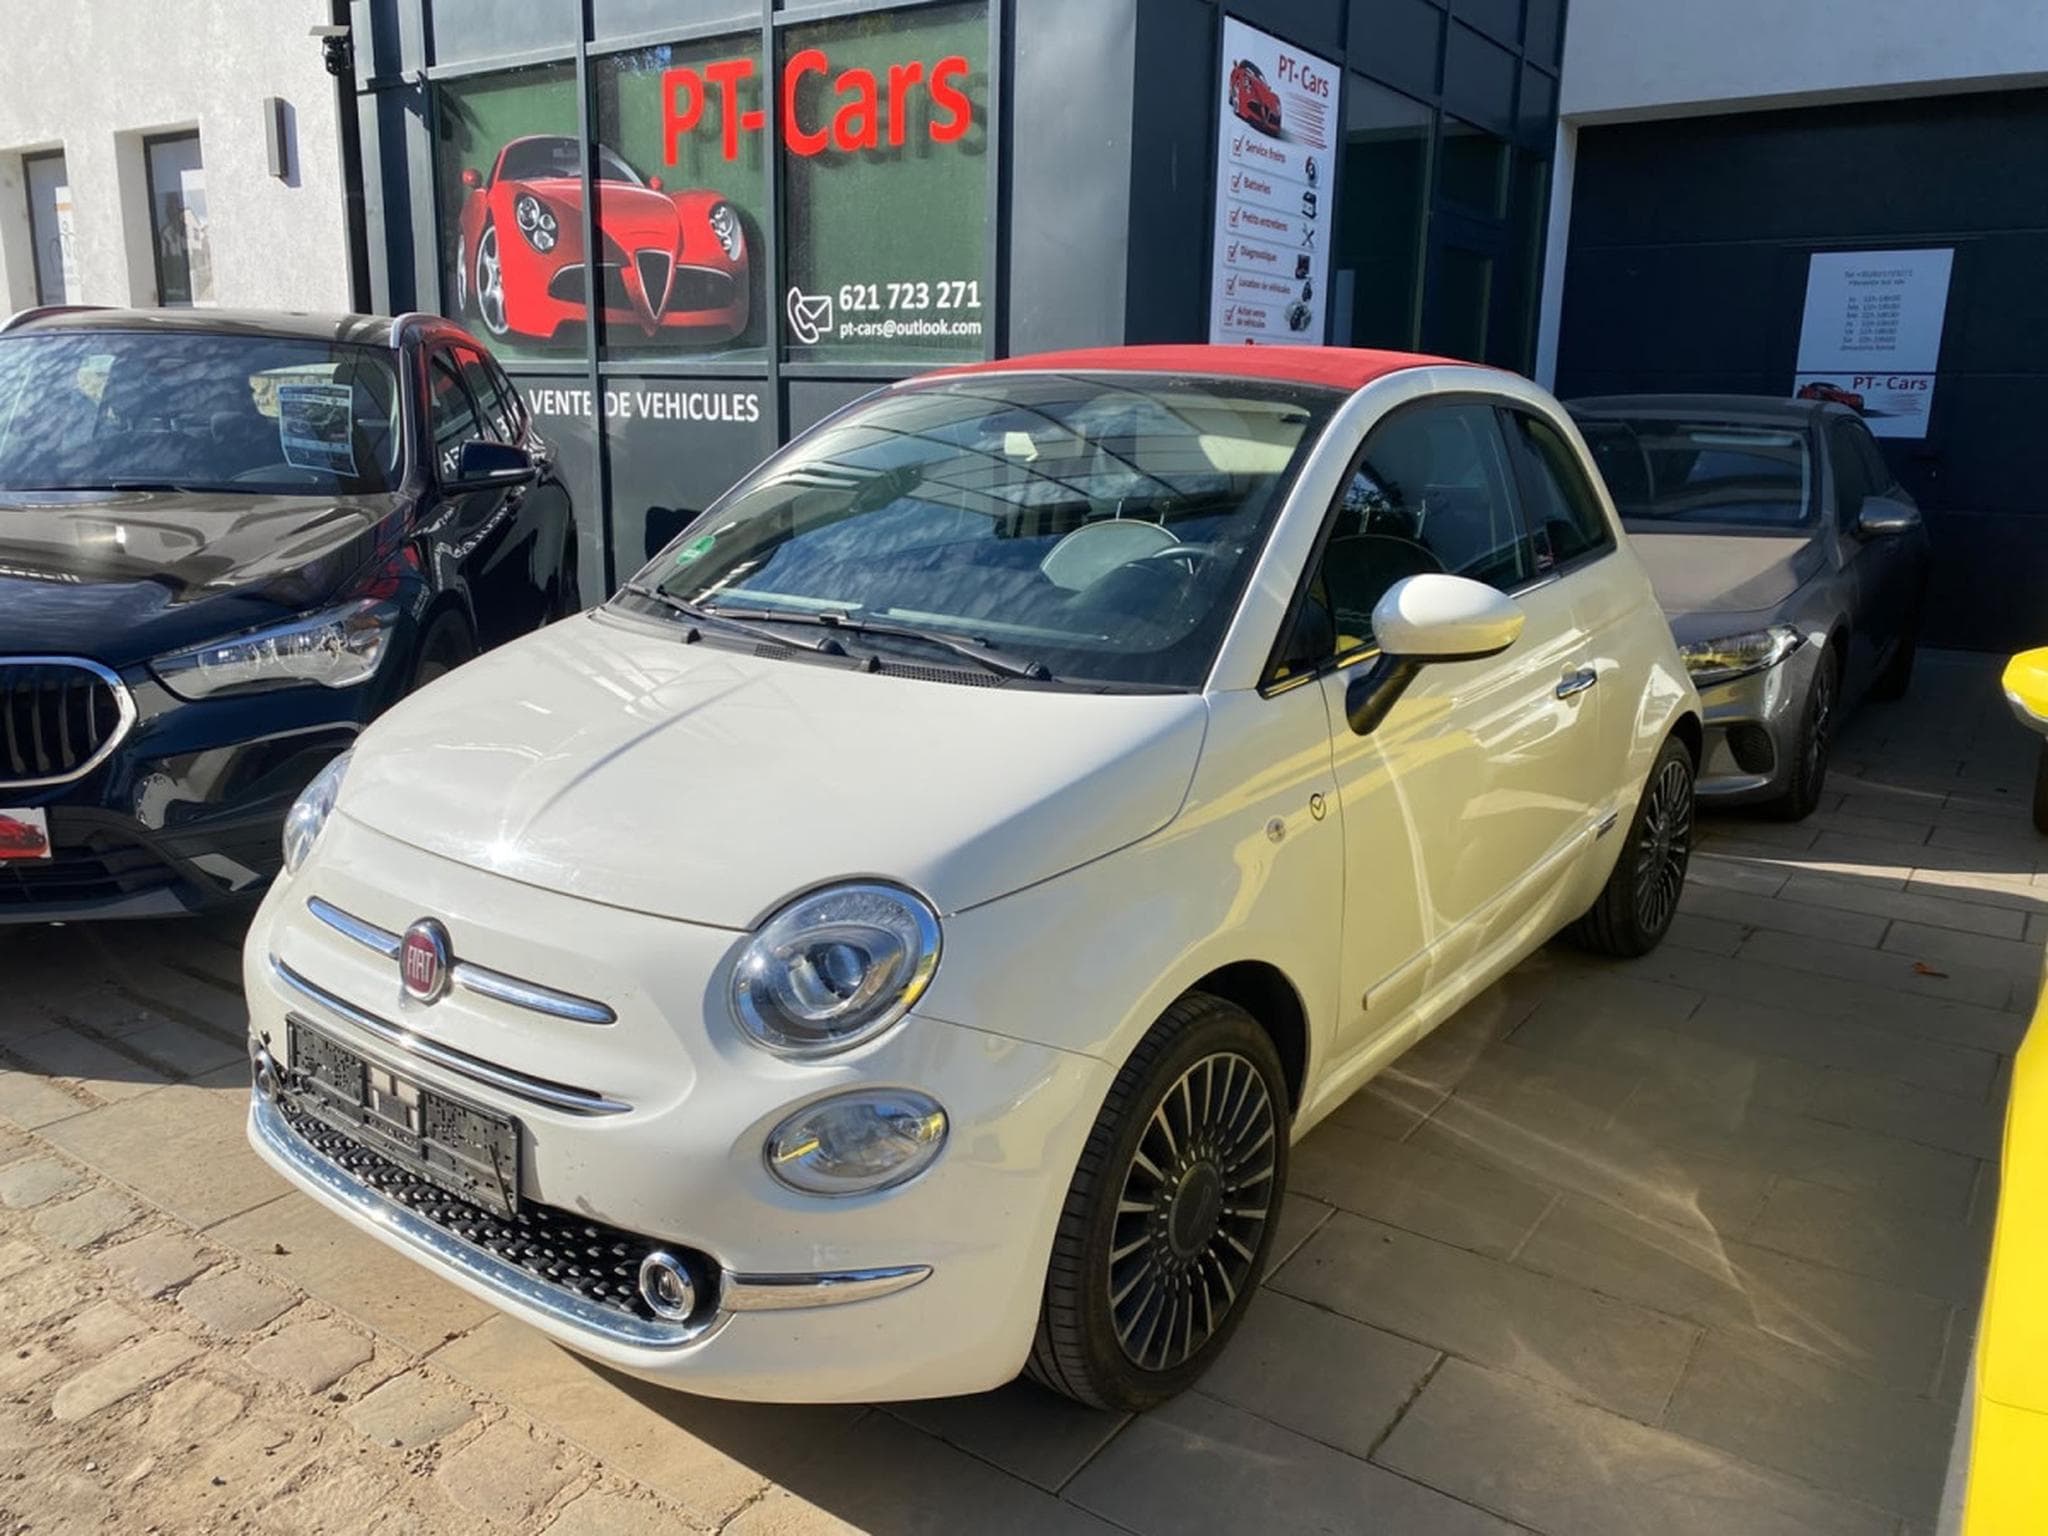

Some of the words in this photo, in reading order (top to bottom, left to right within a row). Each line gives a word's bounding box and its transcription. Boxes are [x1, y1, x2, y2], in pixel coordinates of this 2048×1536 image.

[1301, 65, 1329, 98] Cars
[783, 48, 972, 157] Cars
[1245, 140, 1268, 157] Service
[1243, 176, 1272, 195] Batteries
[839, 284, 880, 311] 621
[887, 282, 930, 310] 723
[936, 281, 981, 309] 271
[839, 318, 982, 340] pt-cars@outlook.com
[1886, 375, 1929, 392] Cars
[529, 389, 593, 416] VENTE
[603, 391, 631, 418] DE
[636, 391, 761, 423] VEHICULES
[406, 944, 434, 984] FIAT
